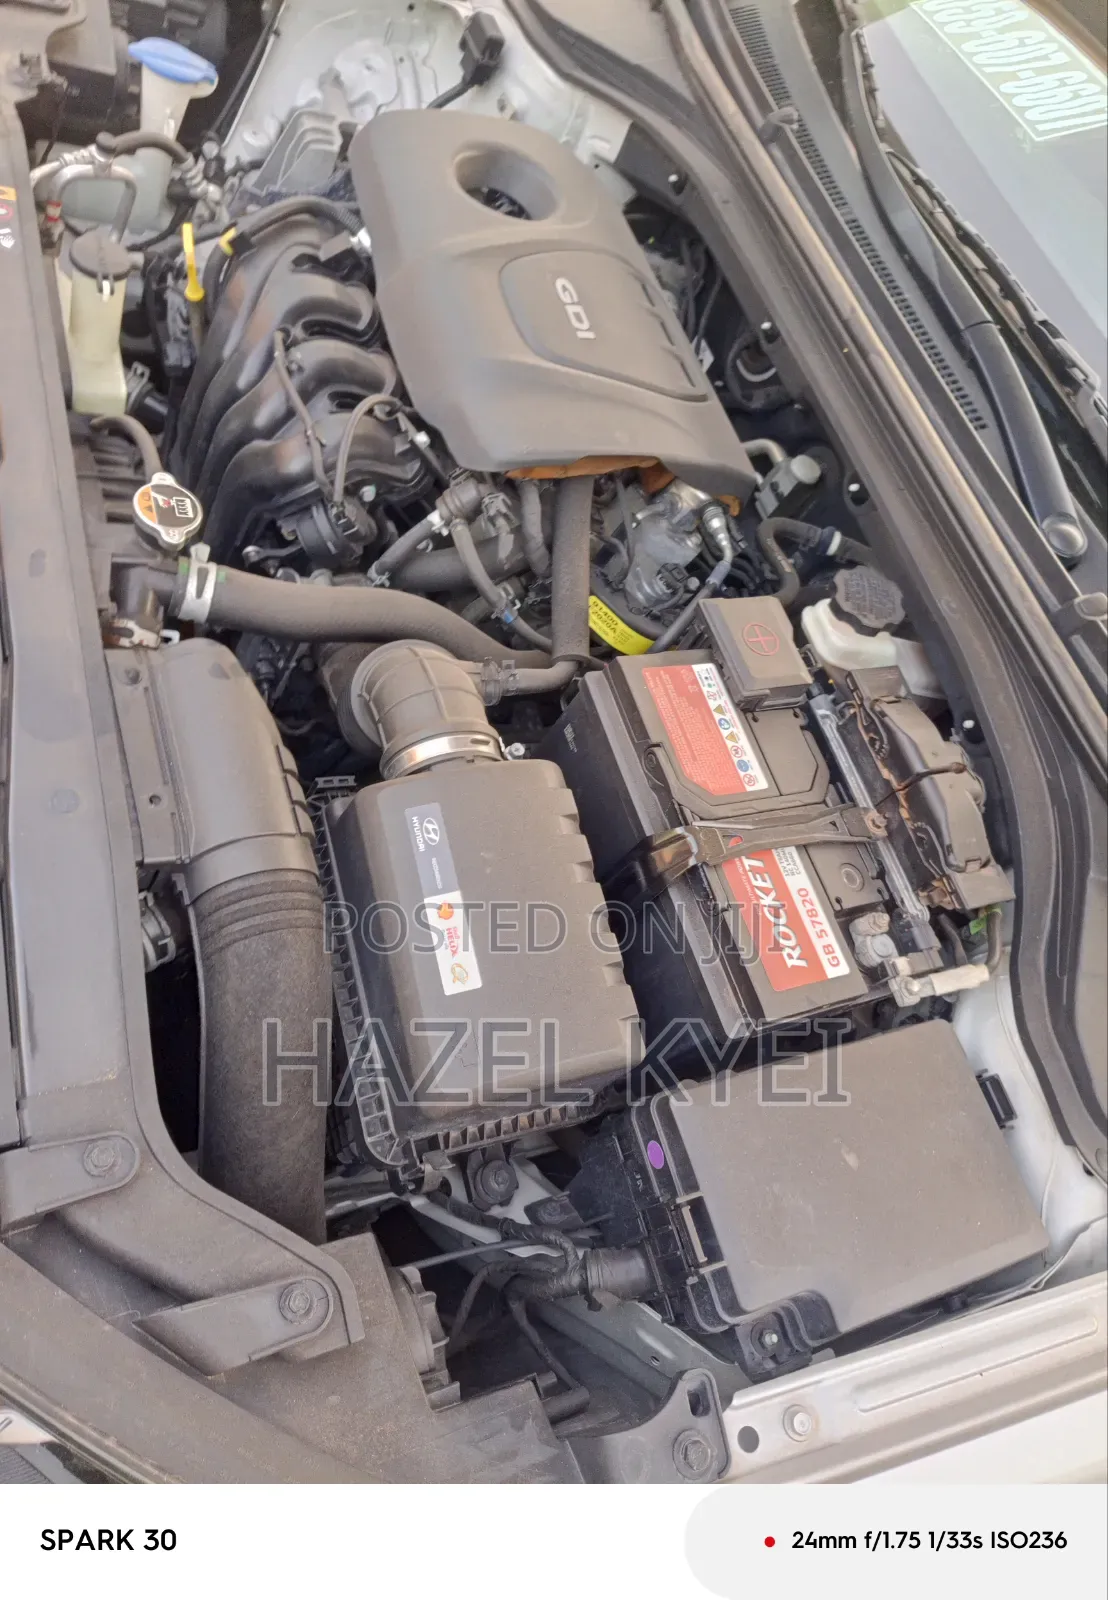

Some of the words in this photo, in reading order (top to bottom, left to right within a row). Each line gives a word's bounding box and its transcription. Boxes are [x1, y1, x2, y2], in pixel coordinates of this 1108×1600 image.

[555, 277, 597, 339] GDI
[412, 816, 425, 852] HYUNDAI
[741, 856, 808, 969] ROCKET
[796, 887, 830, 939] 57820
[446, 928, 459, 958] HELIX
[822, 940, 841, 968] GB
